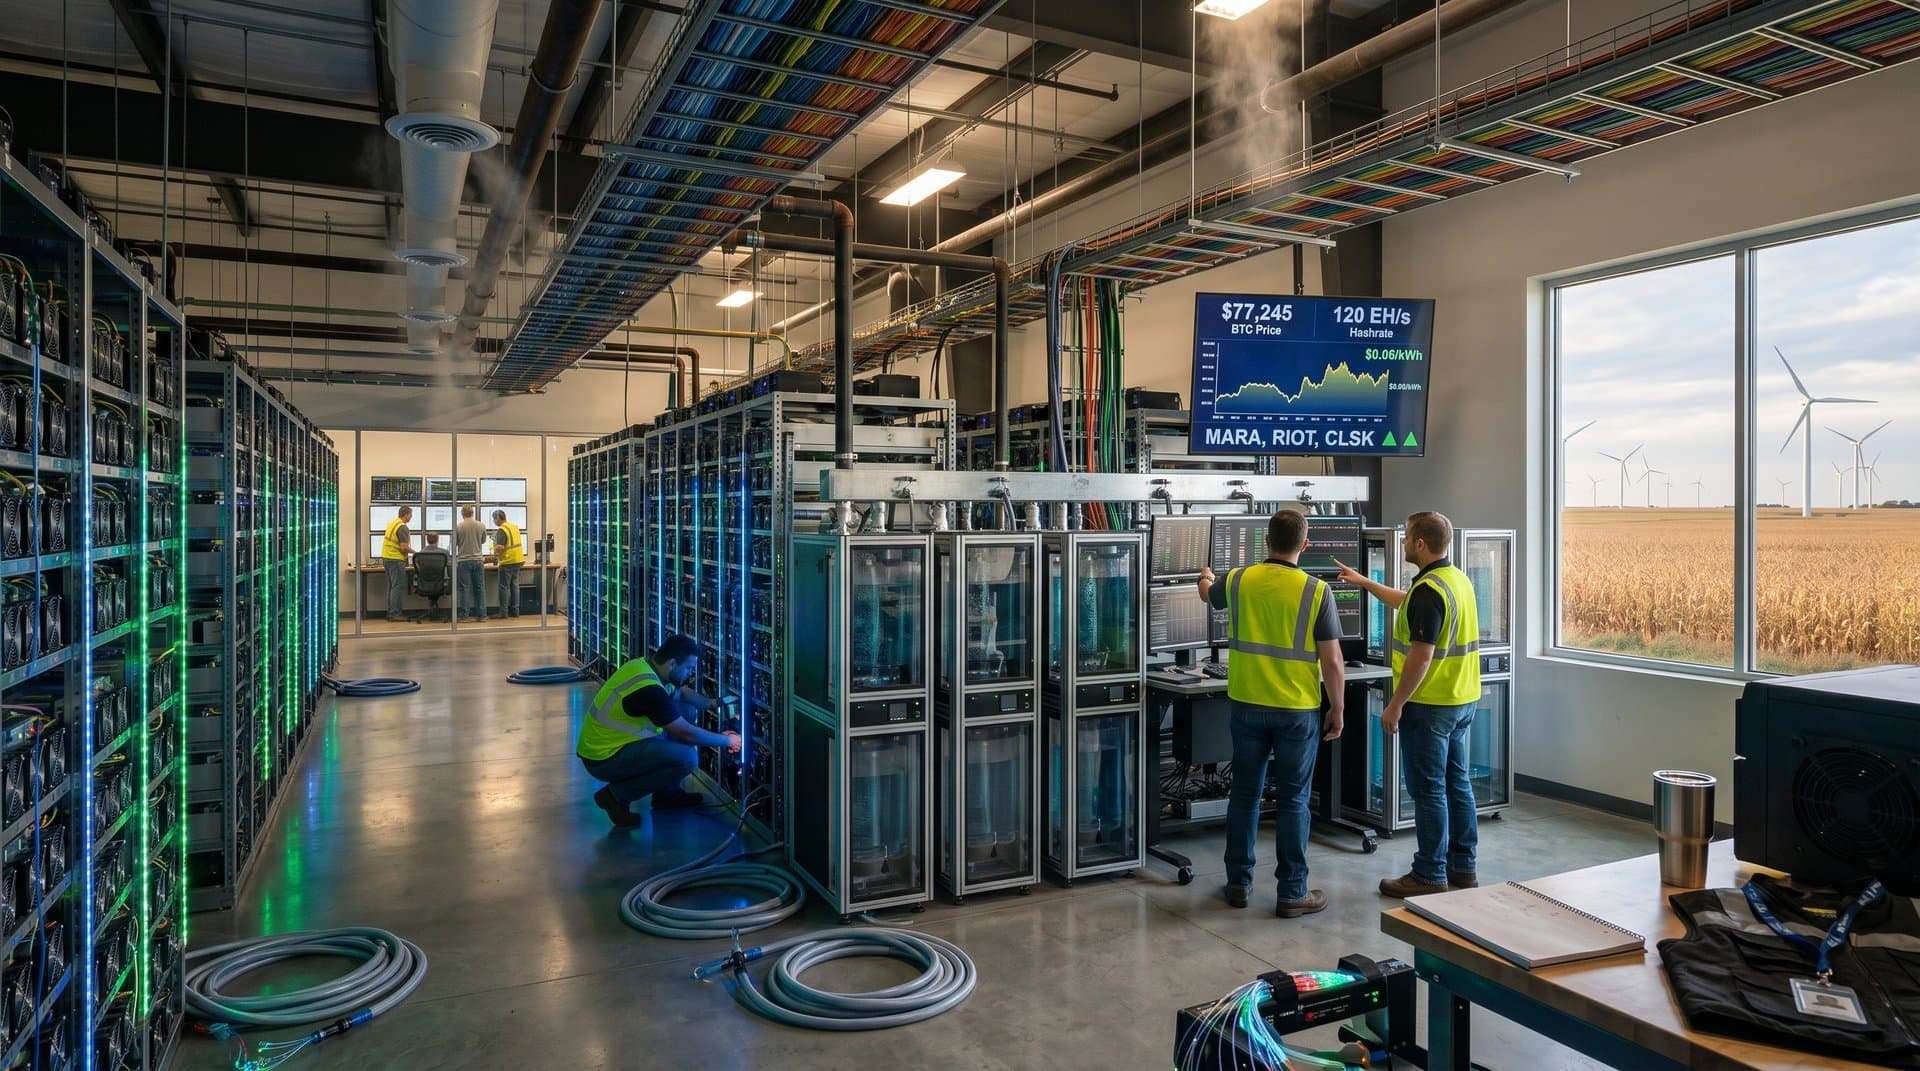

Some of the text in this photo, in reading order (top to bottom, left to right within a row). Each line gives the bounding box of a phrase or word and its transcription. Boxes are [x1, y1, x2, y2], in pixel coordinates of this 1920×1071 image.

[1221, 302, 1292, 323] $77,245
[1333, 306, 1411, 325] 120 EH/s
[1231, 324, 1282, 336] BTC Price
[1349, 328, 1394, 338] Hashrate
[1365, 348, 1423, 361] $0.06/kWh
[1205, 428, 1375, 449] MARA, RIOT, CLSK
